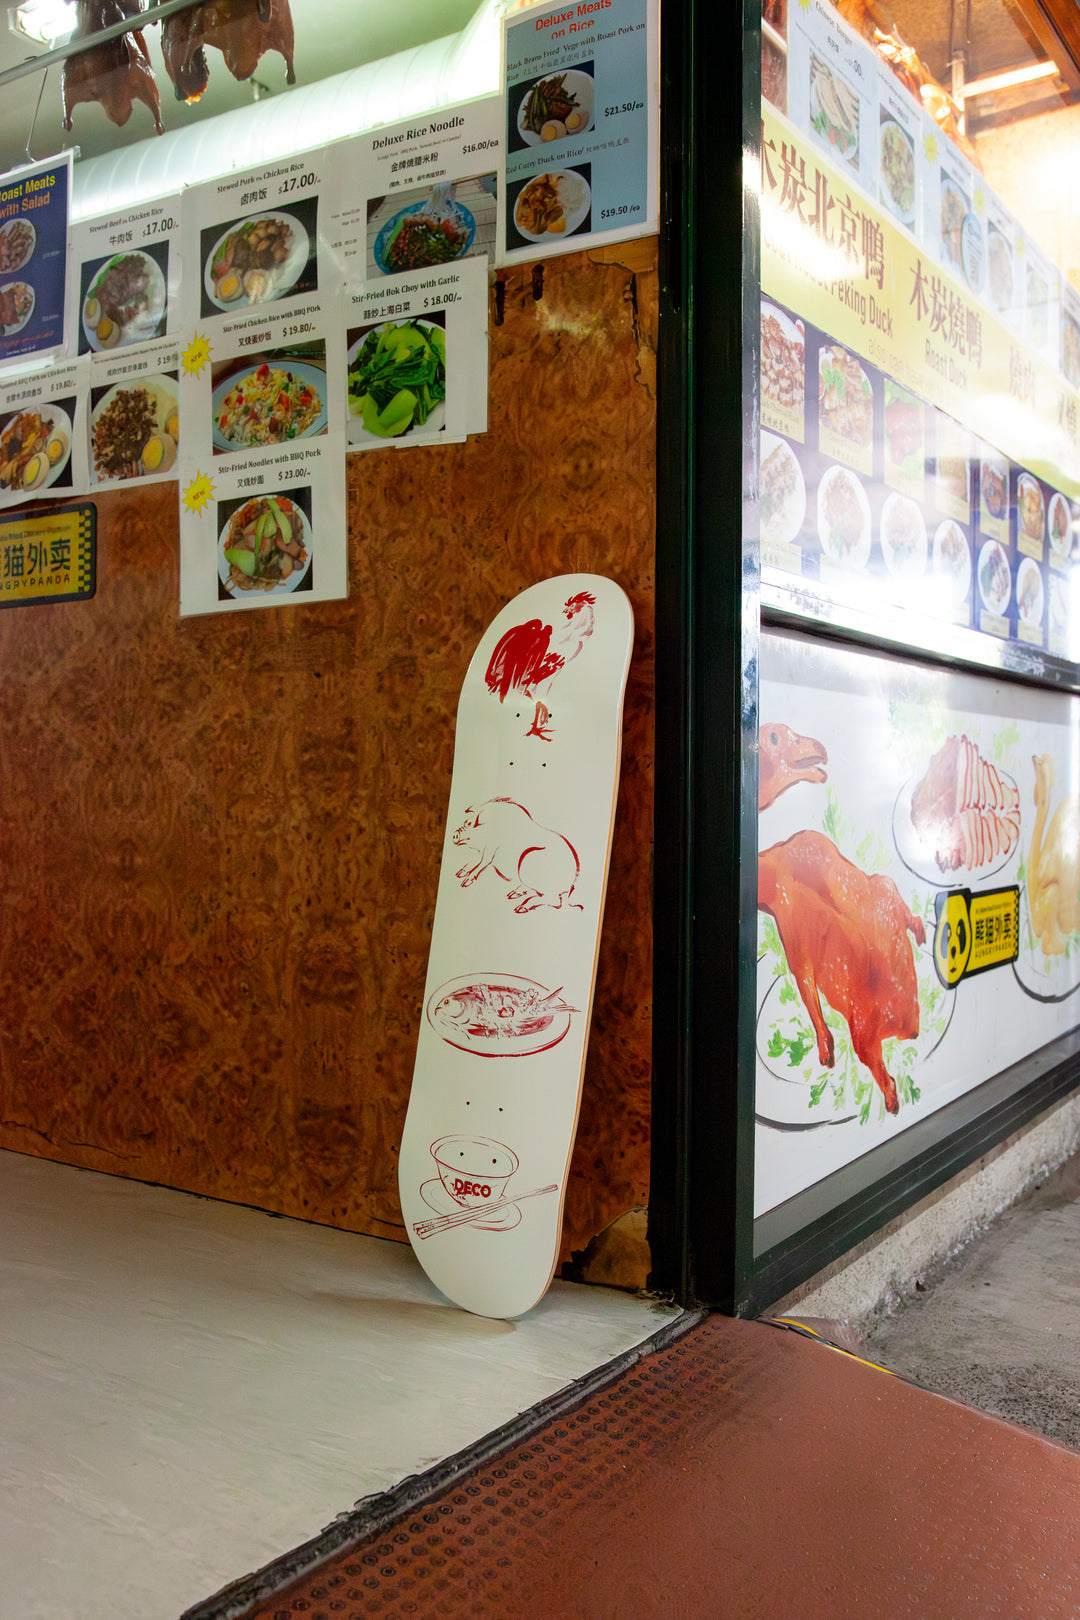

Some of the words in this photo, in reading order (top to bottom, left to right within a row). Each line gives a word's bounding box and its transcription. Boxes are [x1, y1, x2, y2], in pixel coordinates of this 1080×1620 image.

[535, 10, 574, 31] Deluxe
[577, 0, 612, 18] Meats
[551, 28, 565, 40] on
[569, 19, 595, 34] Rice
[543, 47, 560, 59] Fried
[563, 42, 579, 53] Vege
[580, 36, 595, 47] with
[597, 31, 616, 42] Roast
[618, 25, 634, 36] Pork
[635, 22, 645, 31] on
[604, 101, 644, 118] $21.50/ea
[372, 133, 404, 151] Deluxe
[406, 127, 427, 141] Rice
[429, 116, 465, 134] Noodle
[462, 139, 499, 154] $16.00/ea
[518, 160, 536, 171] Curry
[537, 155, 555, 166] Duck
[25, 174, 56, 194] Meats
[240, 176, 255, 187] Pork
[263, 168, 289, 180] Chicken
[290, 163, 305, 173] Rice
[22, 191, 50, 212] Salad
[600, 208, 628, 221] $19.50
[352, 289, 385, 304] Stir-Fried
[386, 287, 400, 297] Bok
[401, 283, 419, 294] Choy
[420, 279, 437, 289] with
[438, 274, 460, 286] Garlic
[423, 297, 429, 309] $
[869, 294, 893, 339] Duck
[218, 463, 248, 475] Stir-Fried
[248, 457, 274, 469] Noodles
[274, 455, 289, 465] with
[290, 451, 304, 462] BBQ
[305, 448, 322, 459] Pork
[278, 471, 283, 482] $
[192, 488, 206, 501] NEW
[0, 538, 71, 578] 猫外卖
